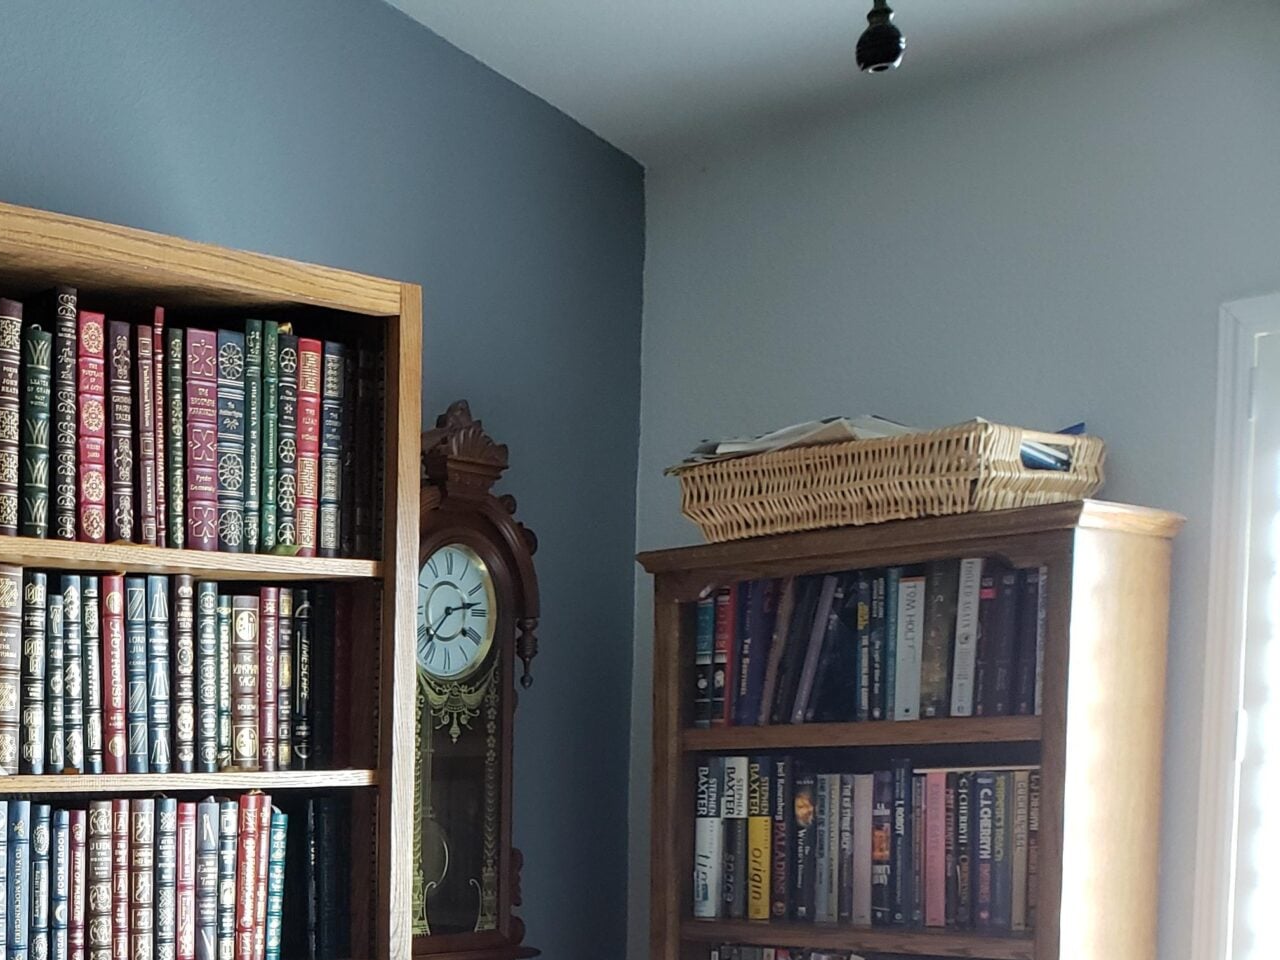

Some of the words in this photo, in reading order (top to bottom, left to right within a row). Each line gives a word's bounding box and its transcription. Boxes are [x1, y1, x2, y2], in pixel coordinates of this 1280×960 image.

[905, 585, 916, 611] TOM
[265, 626, 275, 650] Way
[905, 614, 914, 641] HOLT
[265, 653, 275, 696] Station
[300, 639, 309, 699] TIMESCAPE
[697, 767, 709, 815] BAXTER
[709, 778, 717, 816] STEPHEN
[725, 767, 736, 815] BAXTER
[750, 763, 760, 814] BAXTER
[760, 777, 768, 815] STEPHEN
[980, 808, 991, 859] CHERRYH
